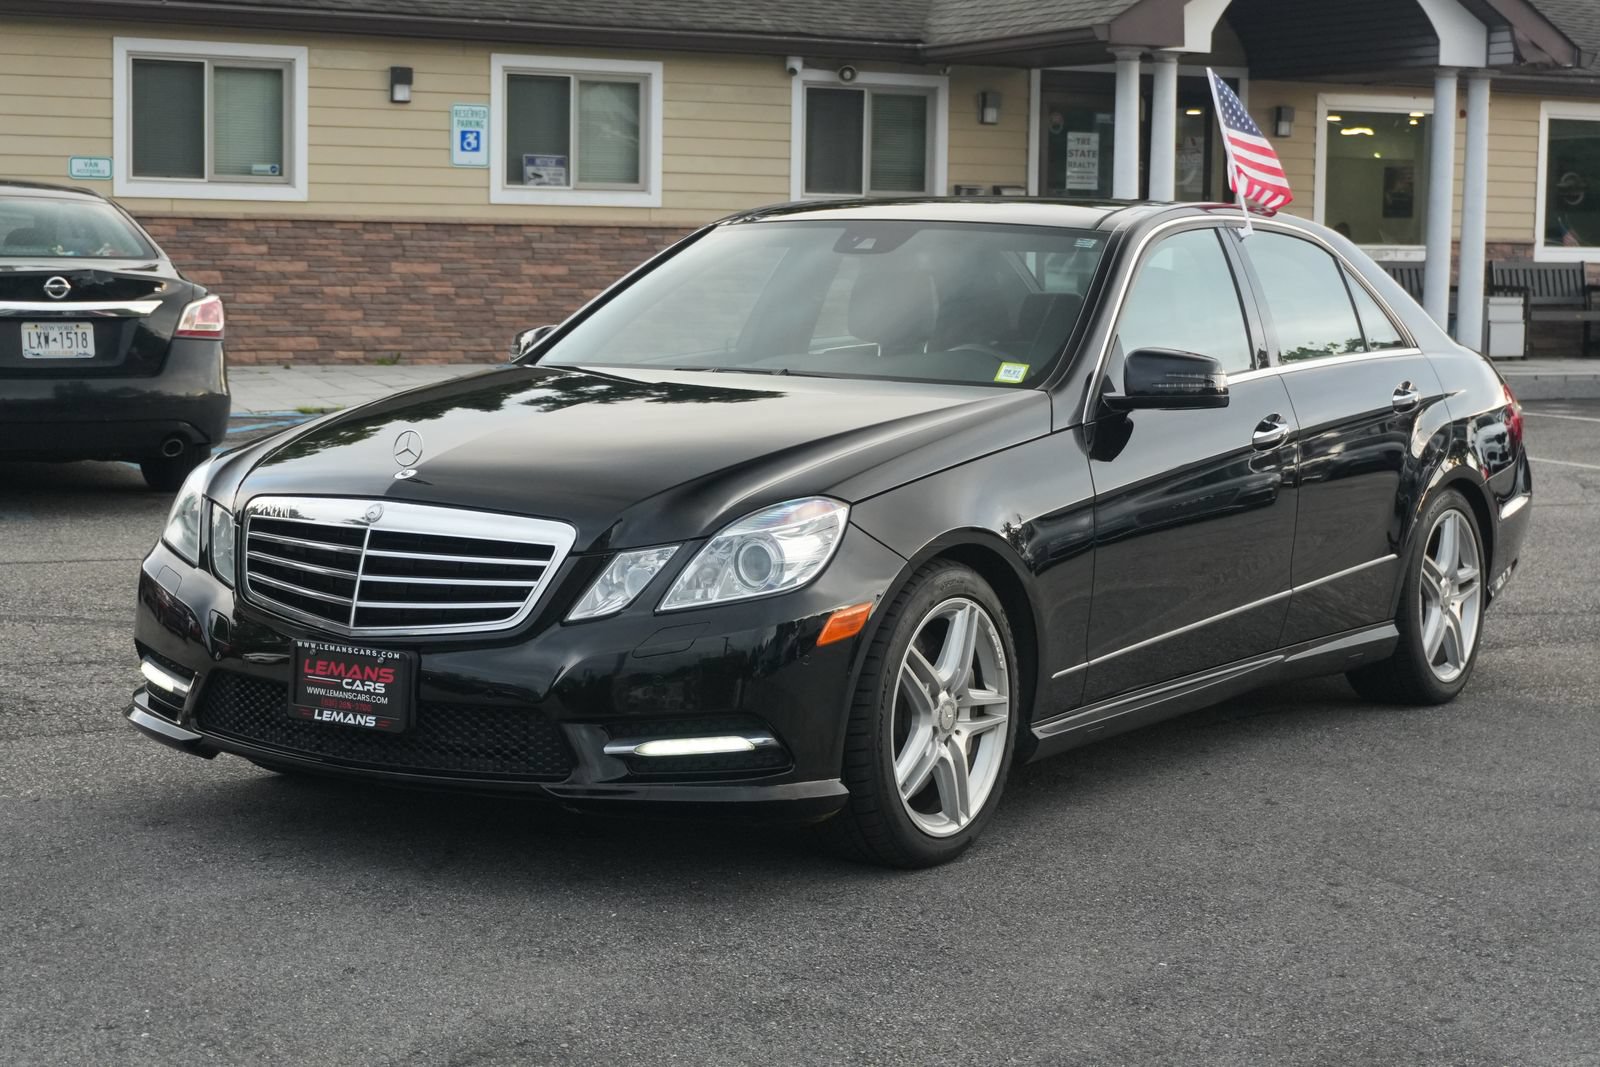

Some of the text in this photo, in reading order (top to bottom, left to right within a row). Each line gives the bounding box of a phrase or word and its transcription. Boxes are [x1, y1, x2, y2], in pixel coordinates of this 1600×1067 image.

[454, 109, 487, 119] RESERVED
[456, 119, 484, 129] PARKING
[1067, 149, 1097, 159] STATE
[297, 641, 400, 660] WWW.LEMANSCARS.COM
[304, 659, 396, 684] LEMANS
[342, 678, 386, 694] CARS
[306, 686, 389, 705] WWW.LEMANSCARS.COM
[314, 708, 377, 727] LEMANS
